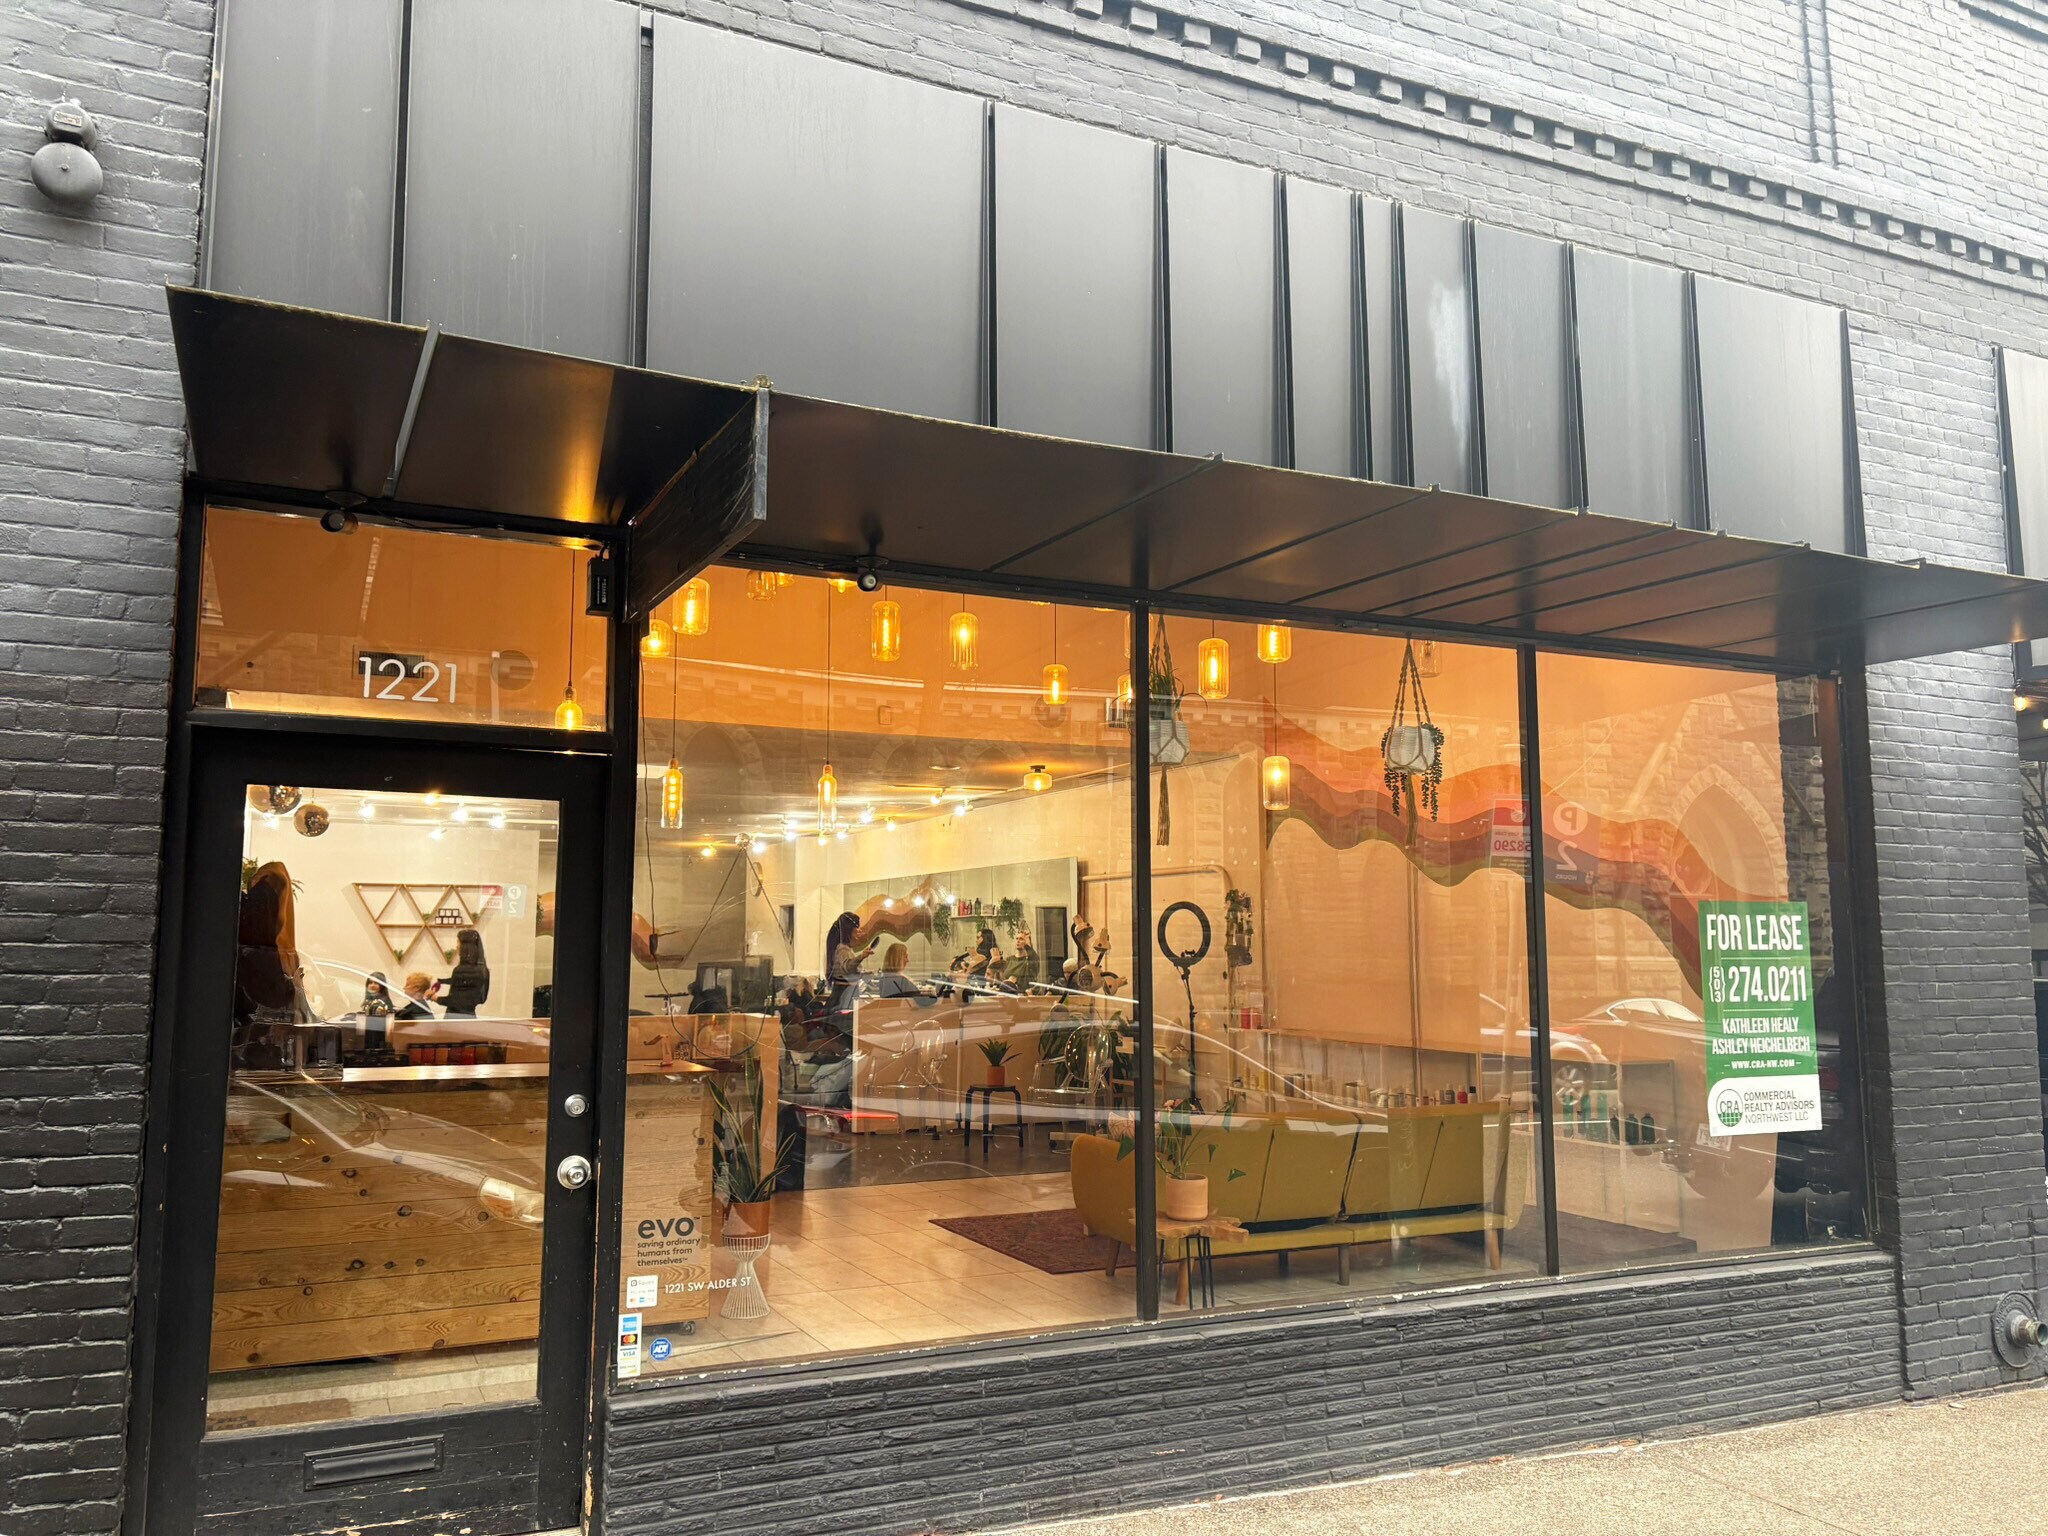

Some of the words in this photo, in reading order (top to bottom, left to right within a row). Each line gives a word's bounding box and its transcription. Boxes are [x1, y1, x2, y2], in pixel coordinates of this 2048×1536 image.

[359, 656, 458, 704] 1221
[1706, 914, 1743, 951] FOR
[1747, 914, 1804, 950] LEASE
[1729, 966, 1807, 1003] 274.0211
[1722, 1017, 1770, 1034] KATHLEEN
[1771, 1016, 1799, 1033] HEALY
[1712, 1038, 1749, 1055] ASHLEY
[1750, 1036, 1811, 1053] HEICHELBECH
[1731, 1059, 1795, 1069] WWW.CRA-NW.COM
[1744, 1090, 1797, 1102] COMMERCIAL
[1720, 1100, 1740, 1113] CRA
[1744, 1102, 1773, 1113] REALTY
[1775, 1100, 1815, 1111] ADVISORS
[1745, 1112, 1793, 1124] NORTHWEST
[1795, 1111, 1809, 1121] LLC
[638, 1217, 695, 1239] evo
[637, 1240, 664, 1249] saving
[666, 1238, 701, 1247] ordinary
[637, 1250, 671, 1258] humans
[672, 1247, 693, 1255] from
[664, 1283, 685, 1294] 1221
[687, 1281, 705, 1292] SW
[708, 1278, 738, 1290] ALDER
[740, 1276, 752, 1287] ST
[653, 1344, 669, 1354] ADT
